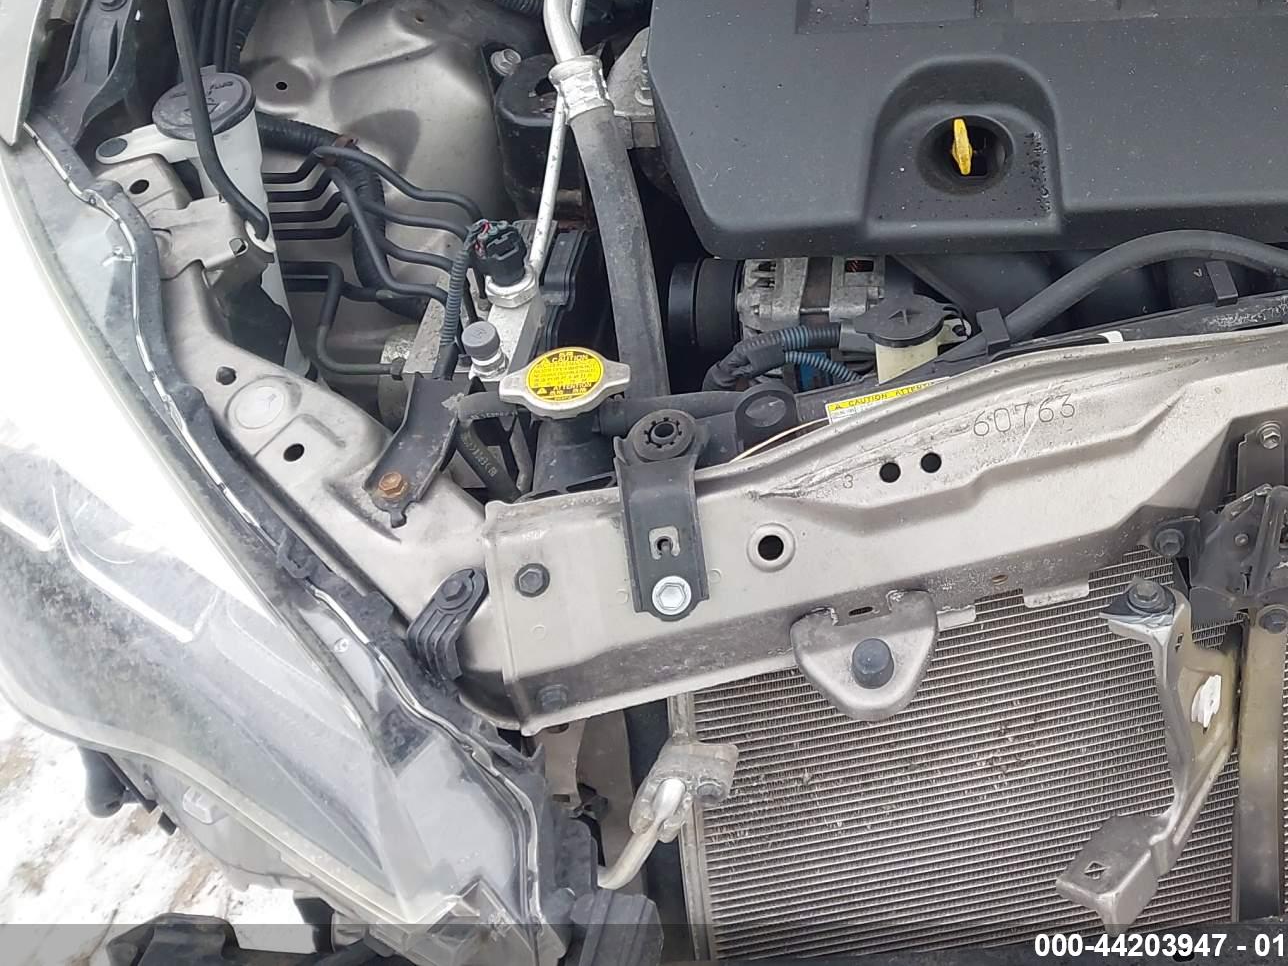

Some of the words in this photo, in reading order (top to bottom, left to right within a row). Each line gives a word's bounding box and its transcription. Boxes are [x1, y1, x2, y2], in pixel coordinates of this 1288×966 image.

[551, 353, 589, 363] CAUTION
[553, 381, 592, 391] ATTENTION
[848, 393, 888, 406] CAUTION
[973, 393, 1075, 436] 60763
